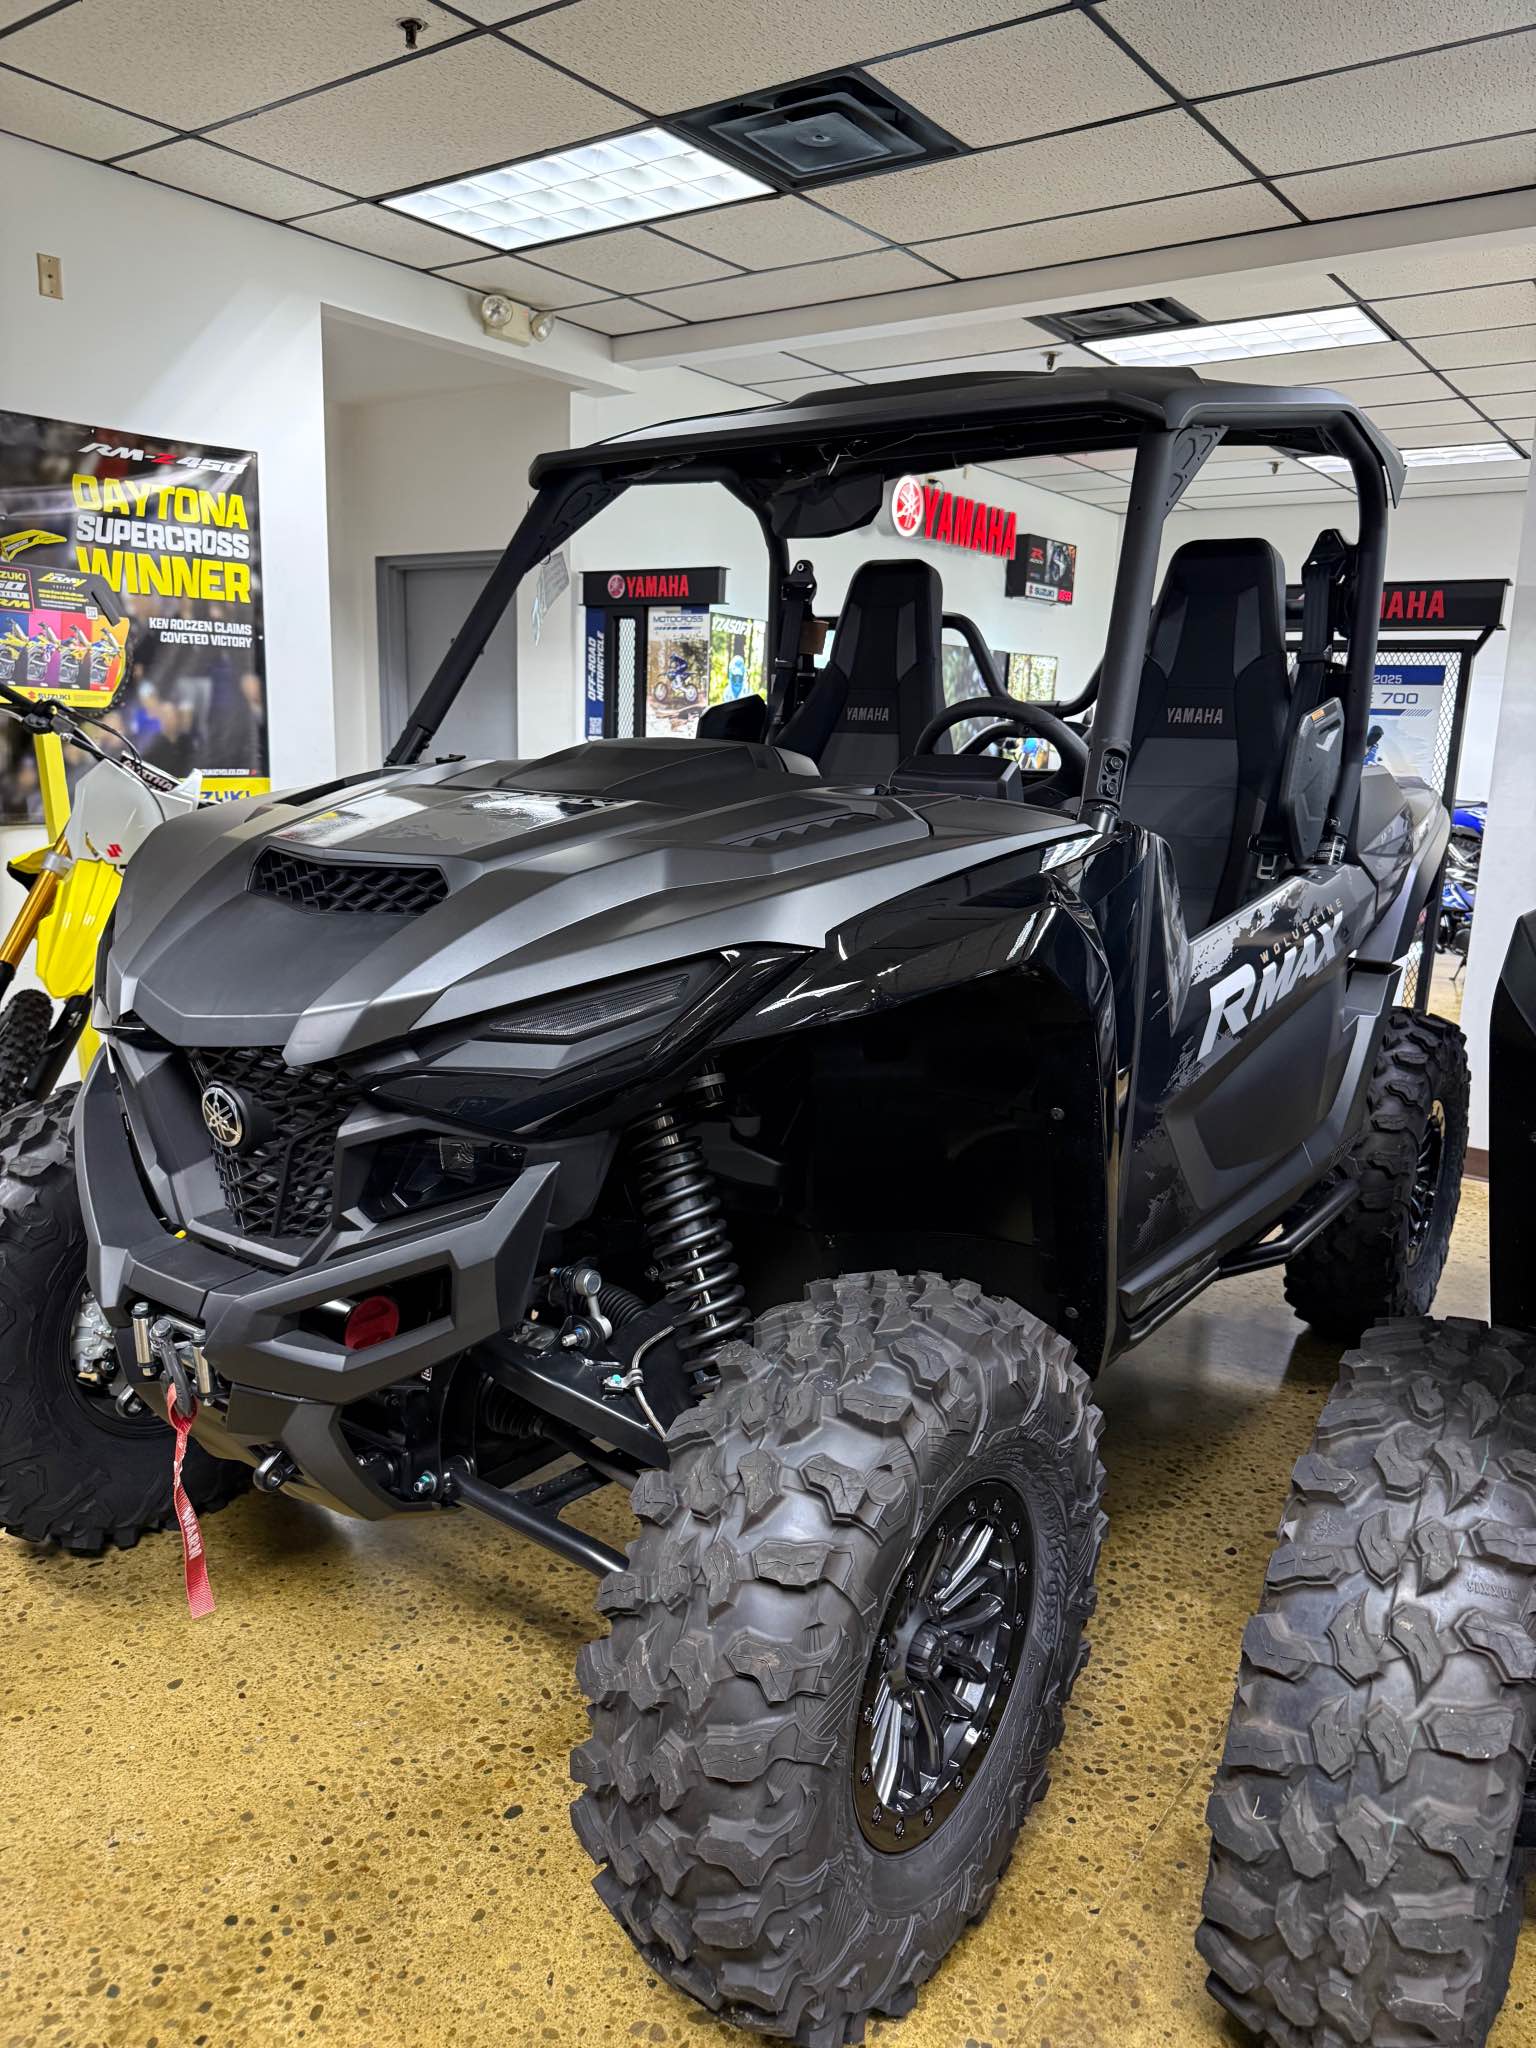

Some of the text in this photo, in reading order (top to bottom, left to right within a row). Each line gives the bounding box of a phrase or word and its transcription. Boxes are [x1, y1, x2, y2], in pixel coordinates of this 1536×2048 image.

[72, 473, 249, 530] DAYTONA
[76, 515, 250, 559] SUPERCROSS
[924, 485, 1017, 560] YAMAHA
[0, 570, 27, 581] ZUKI
[75, 546, 251, 604] WINNER
[626, 574, 689, 598] YAMAHA
[1380, 590, 1445, 619] AHA
[149, 617, 252, 635] KEN ROCZEN CLAIMS
[160, 631, 252, 648] COVETED VICTORY
[587, 636, 597, 702] OFF-ROAD
[596, 630, 605, 702] MOTORCYCLE
[1373, 674, 1403, 685] 2025
[1381, 692, 1419, 704] 700
[847, 707, 889, 721] YAMAHA
[1167, 707, 1223, 724] YAMAHA
[1260, 898, 1343, 964] WOLVERINE
[1196, 910, 1344, 1062] RMAX
